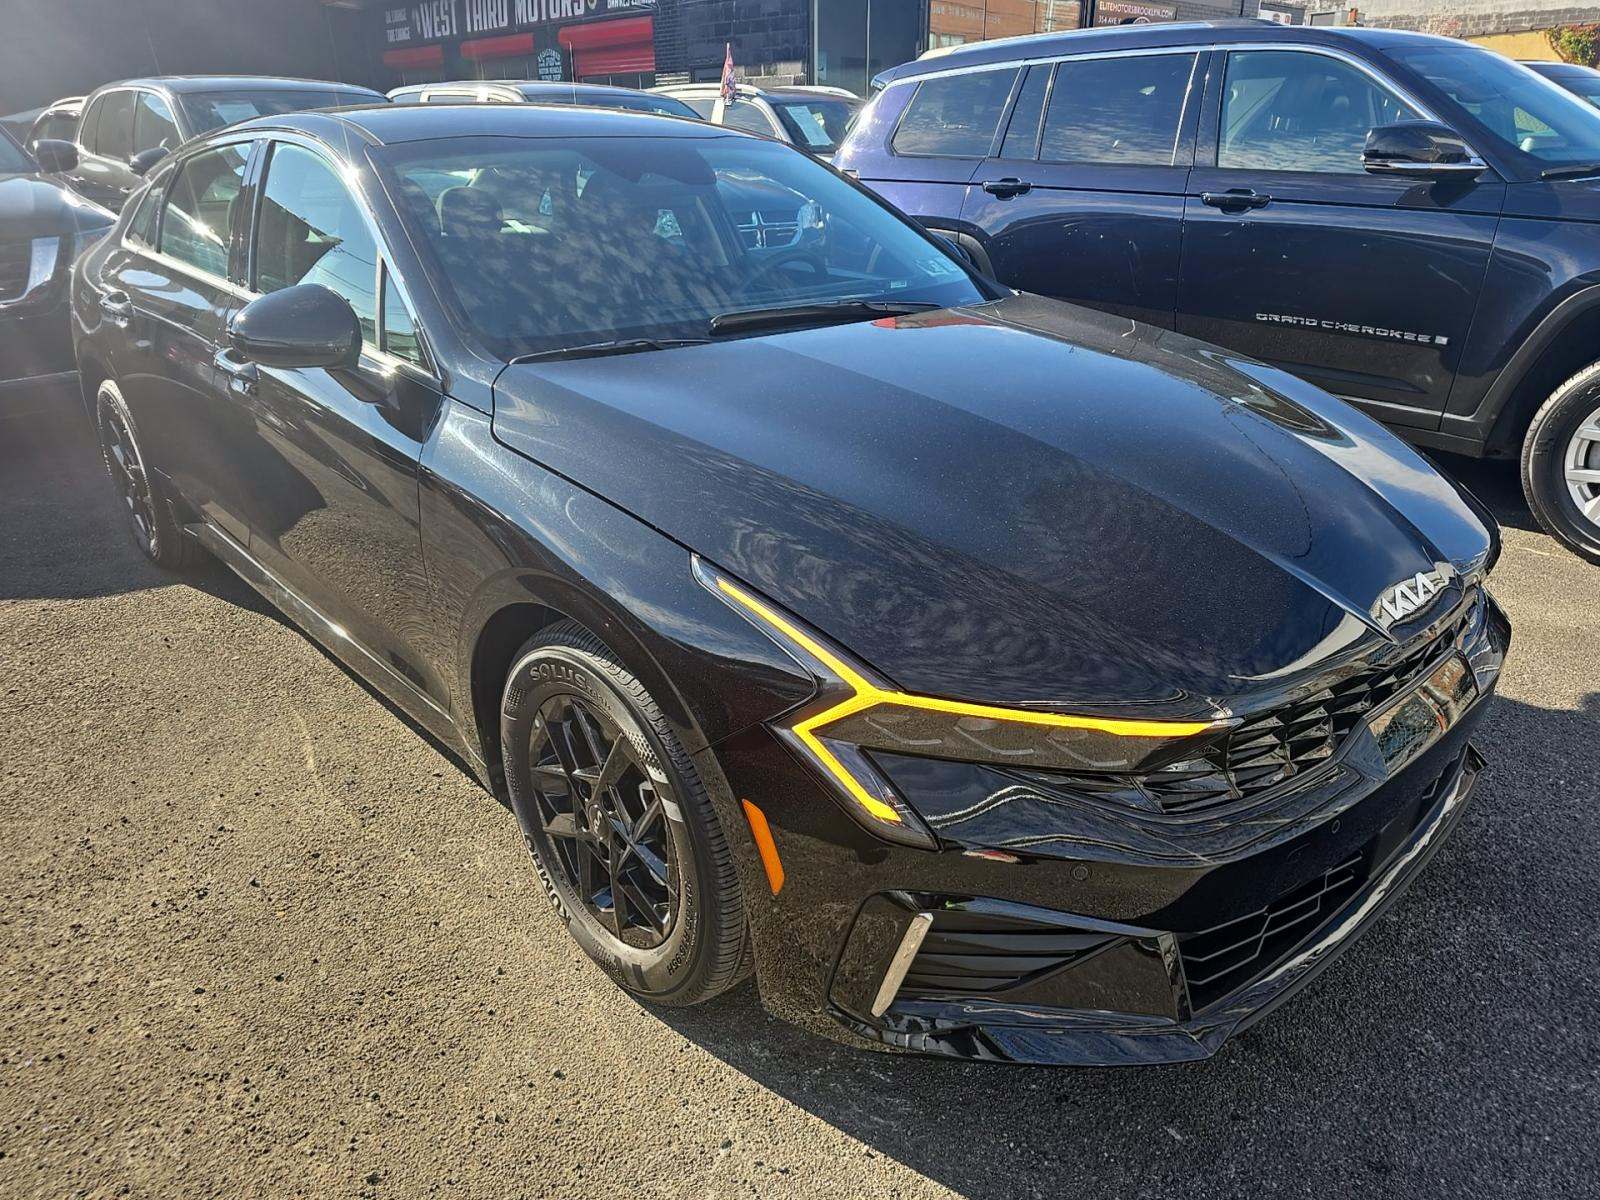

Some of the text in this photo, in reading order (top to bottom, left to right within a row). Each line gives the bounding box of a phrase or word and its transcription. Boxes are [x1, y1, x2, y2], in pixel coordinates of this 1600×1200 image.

[420, 0, 457, 38] WEST
[1255, 313, 1318, 327] GRAND
[1321, 320, 1432, 343] CHEROKEE
[529, 663, 586, 688] SOLUS
